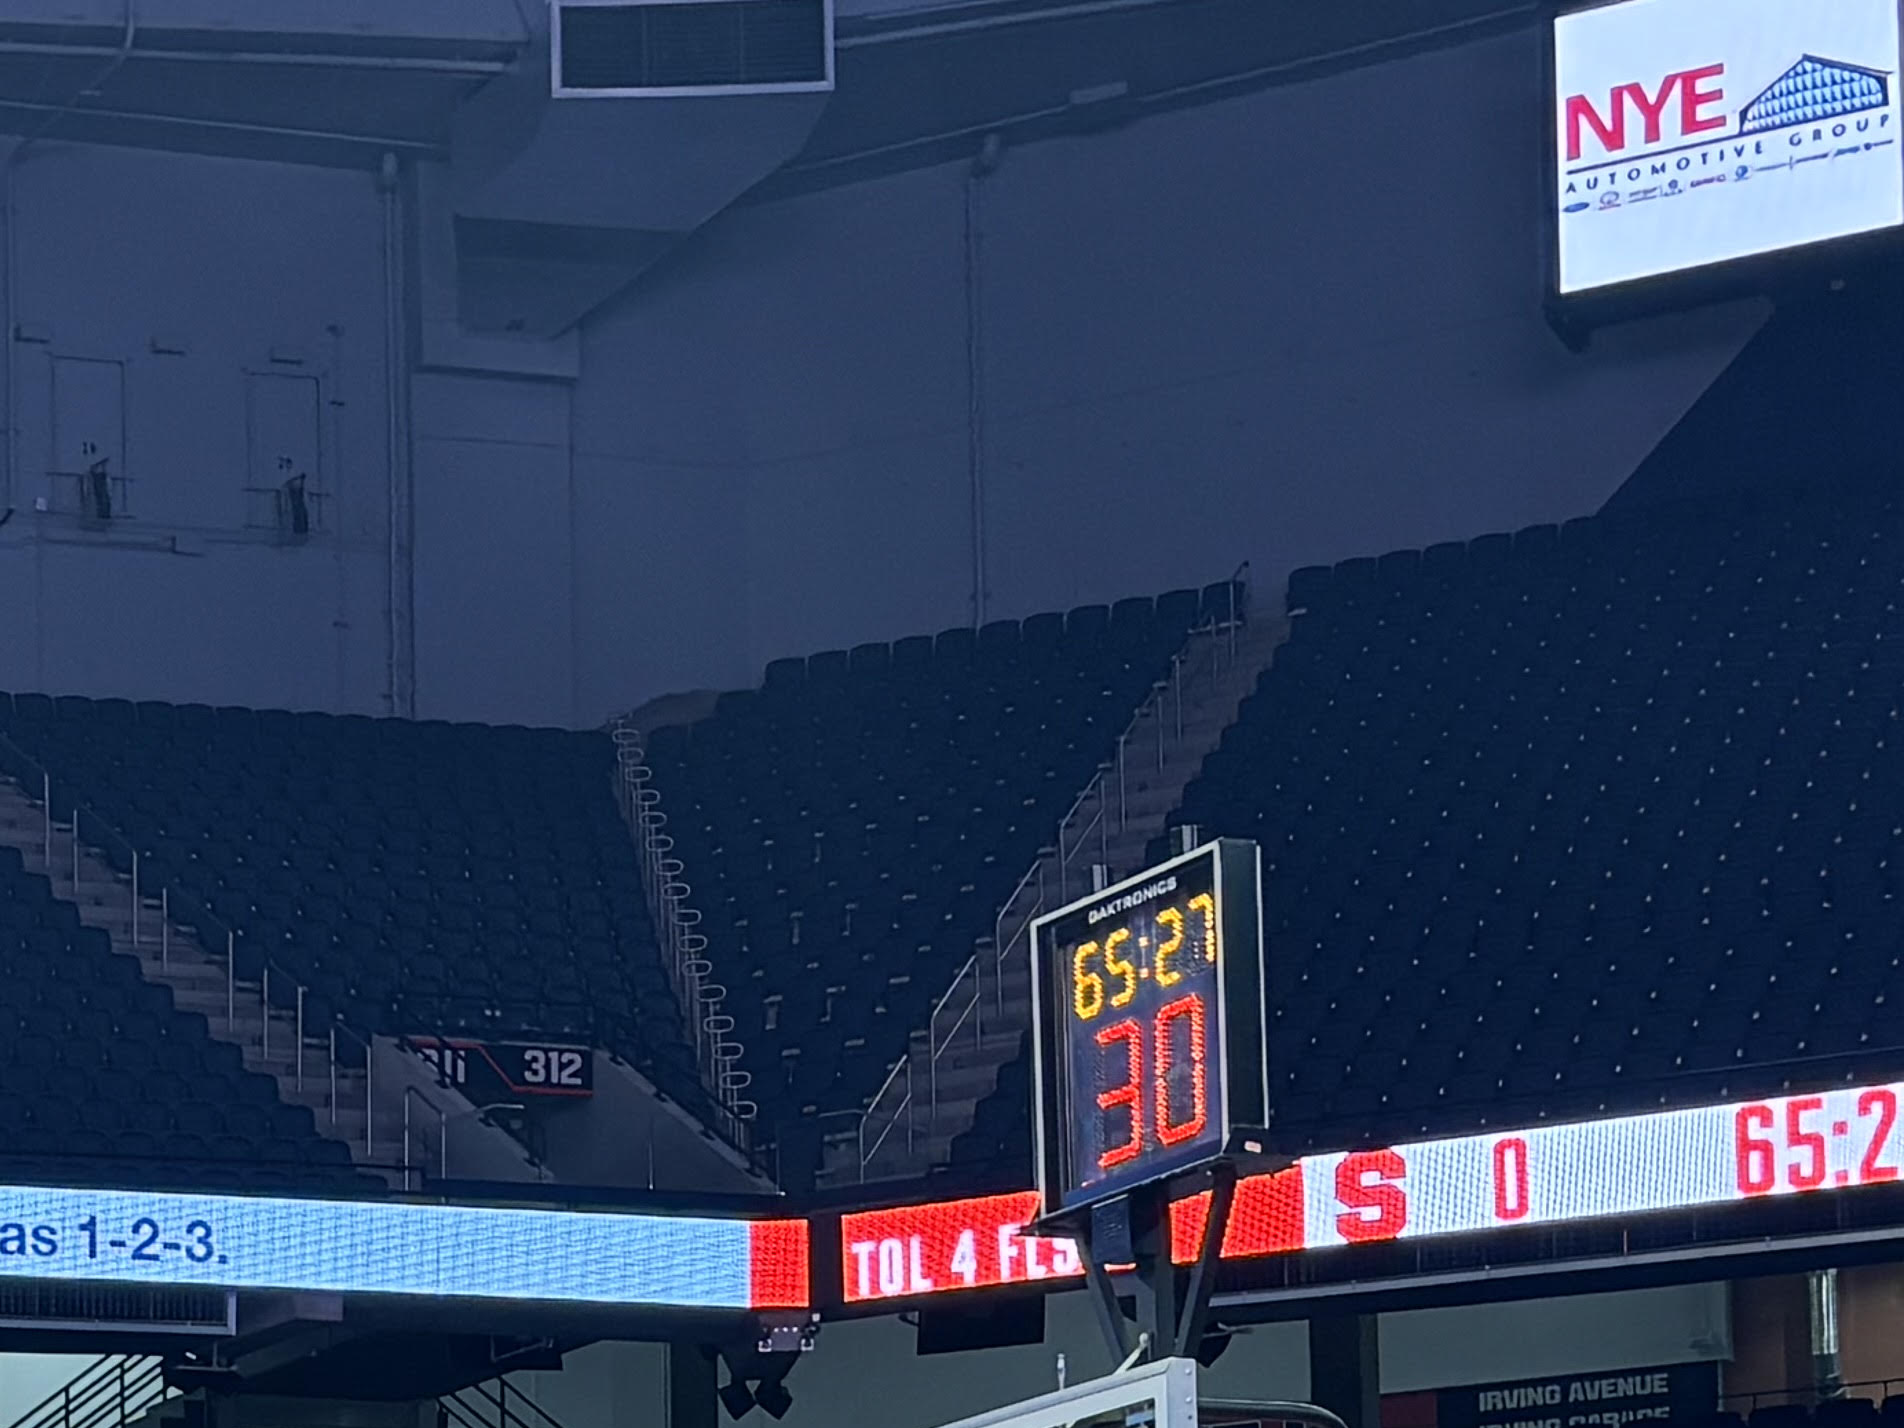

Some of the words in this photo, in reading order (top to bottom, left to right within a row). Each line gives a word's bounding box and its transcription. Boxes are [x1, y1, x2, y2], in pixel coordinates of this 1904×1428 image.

[1566, 63, 1726, 161] NYE
[1566, 141, 1763, 193] AUTOMOTIVE
[1789, 114, 1890, 147] GROUP
[1088, 876, 1177, 924] DAKTRONICS
[1073, 893, 1215, 1020] 65:27
[523, 1049, 583, 1086] 312
[1095, 992, 1206, 1169] 30
[1335, 1150, 1406, 1242] S
[78, 1215, 230, 1264] 1-2-3.
[852, 1234, 932, 1297] TOL
[951, 1229, 977, 1286] 4
[1479, 1385, 1561, 1412] IRVING
[1568, 1373, 1669, 1403] AVENUE
